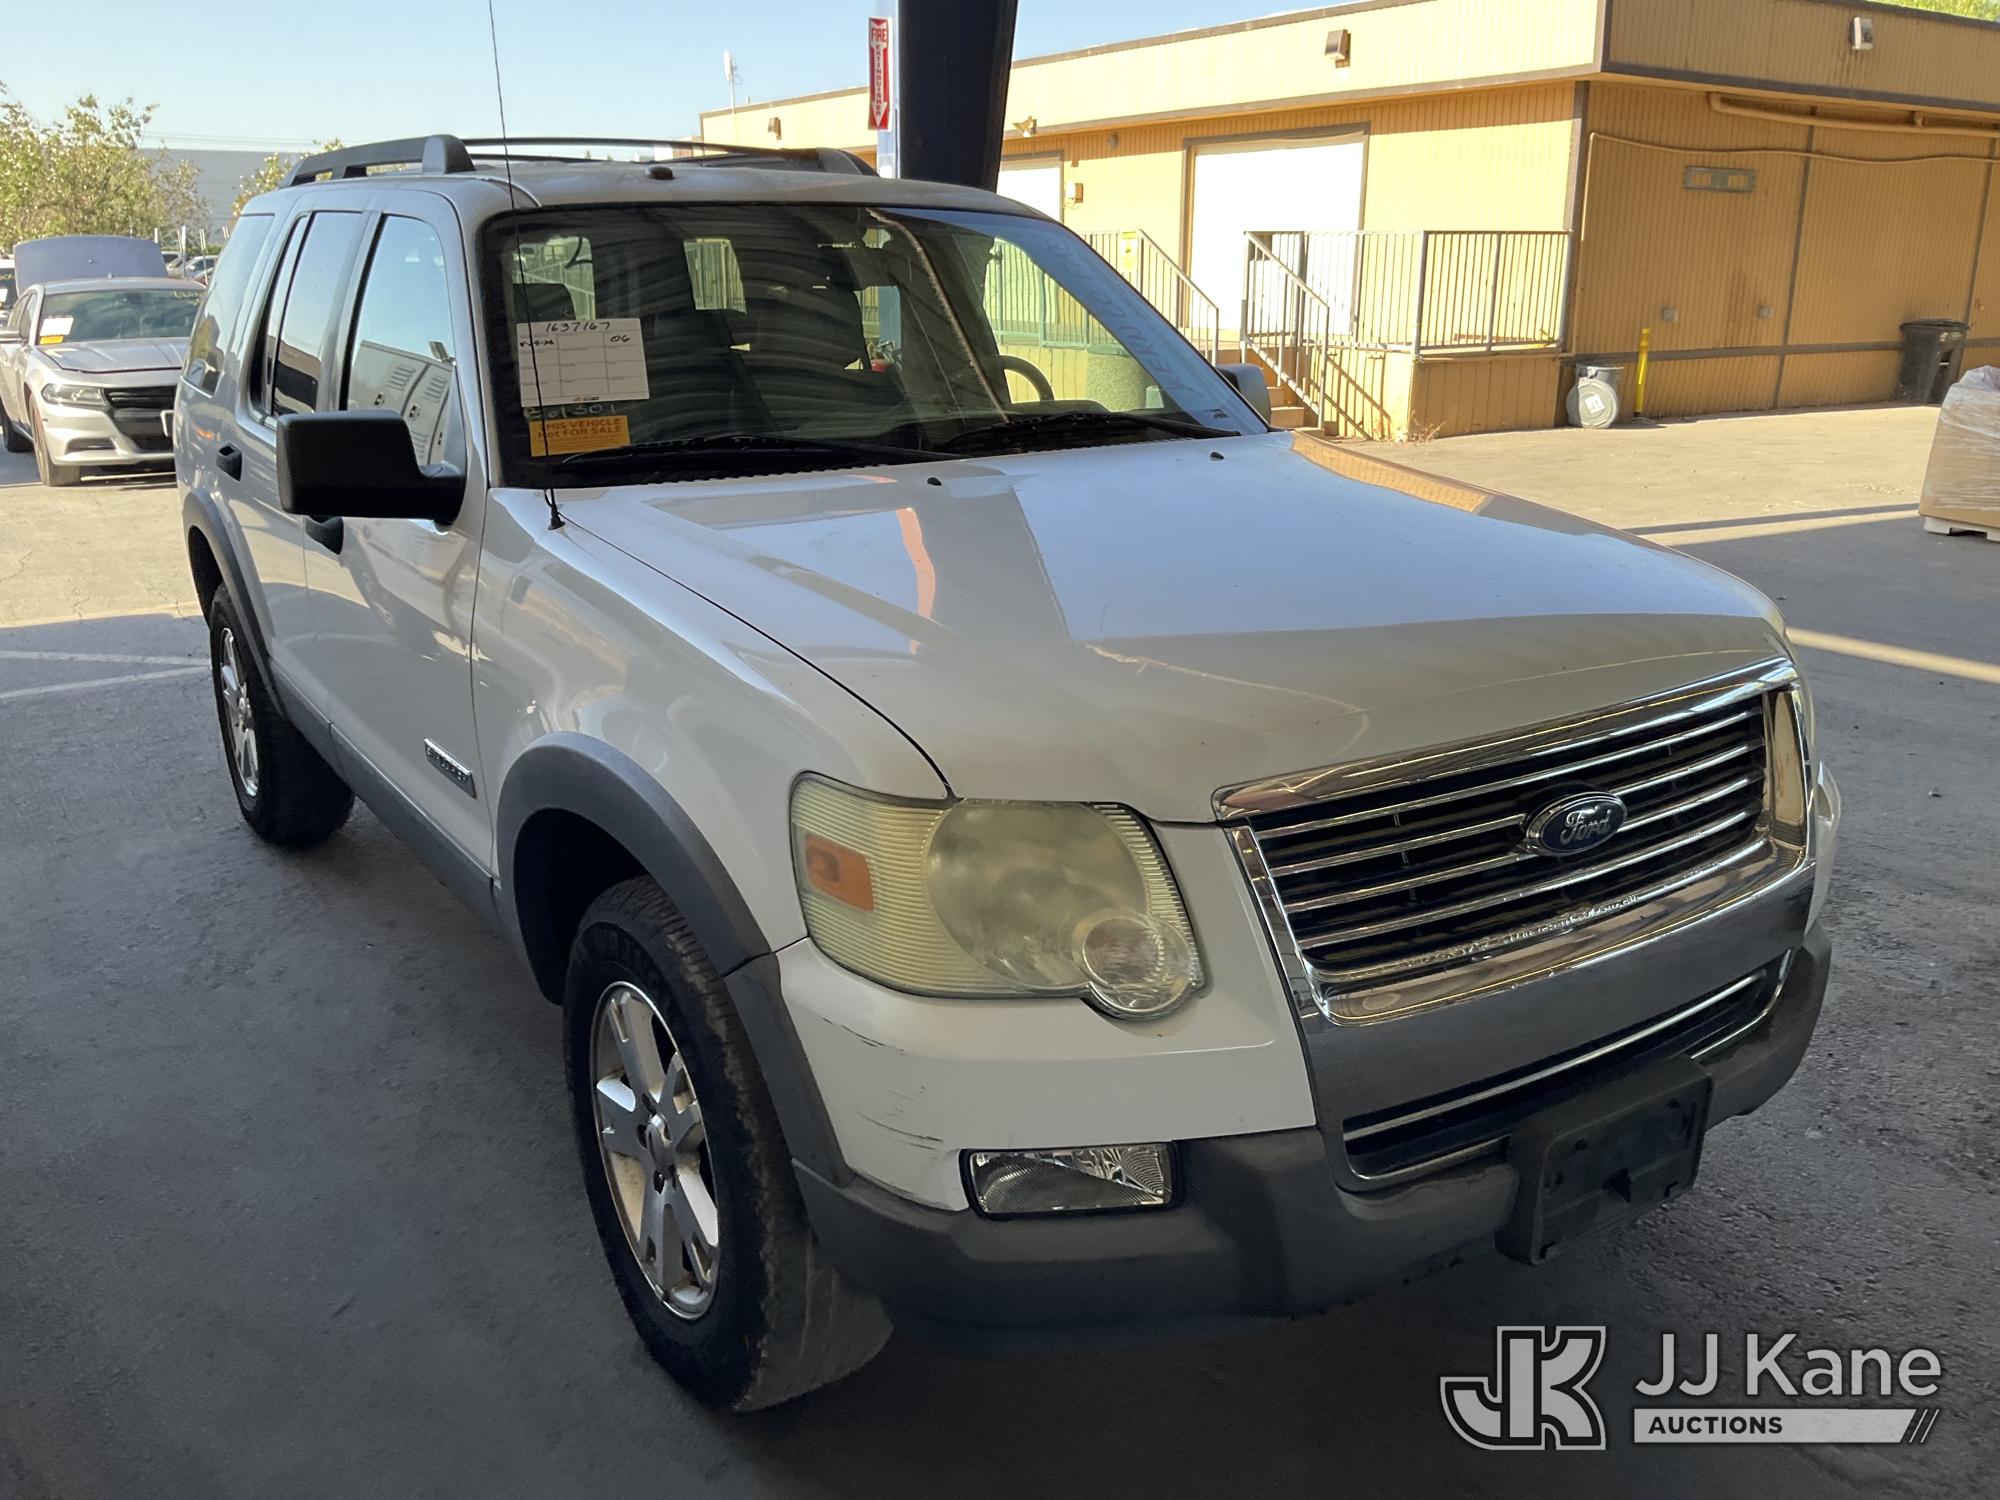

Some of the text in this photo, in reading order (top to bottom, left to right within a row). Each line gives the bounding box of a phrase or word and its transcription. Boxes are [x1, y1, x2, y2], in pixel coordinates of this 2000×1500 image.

[871, 27, 886, 42] FIRE
[545, 321, 611, 333] 1637167
[610, 334, 631, 343] 06
[570, 418, 625, 428] VEHICLE
[563, 428, 588, 436] FOR
[590, 425, 624, 434] SALE
[1560, 806, 1611, 845] Ford
